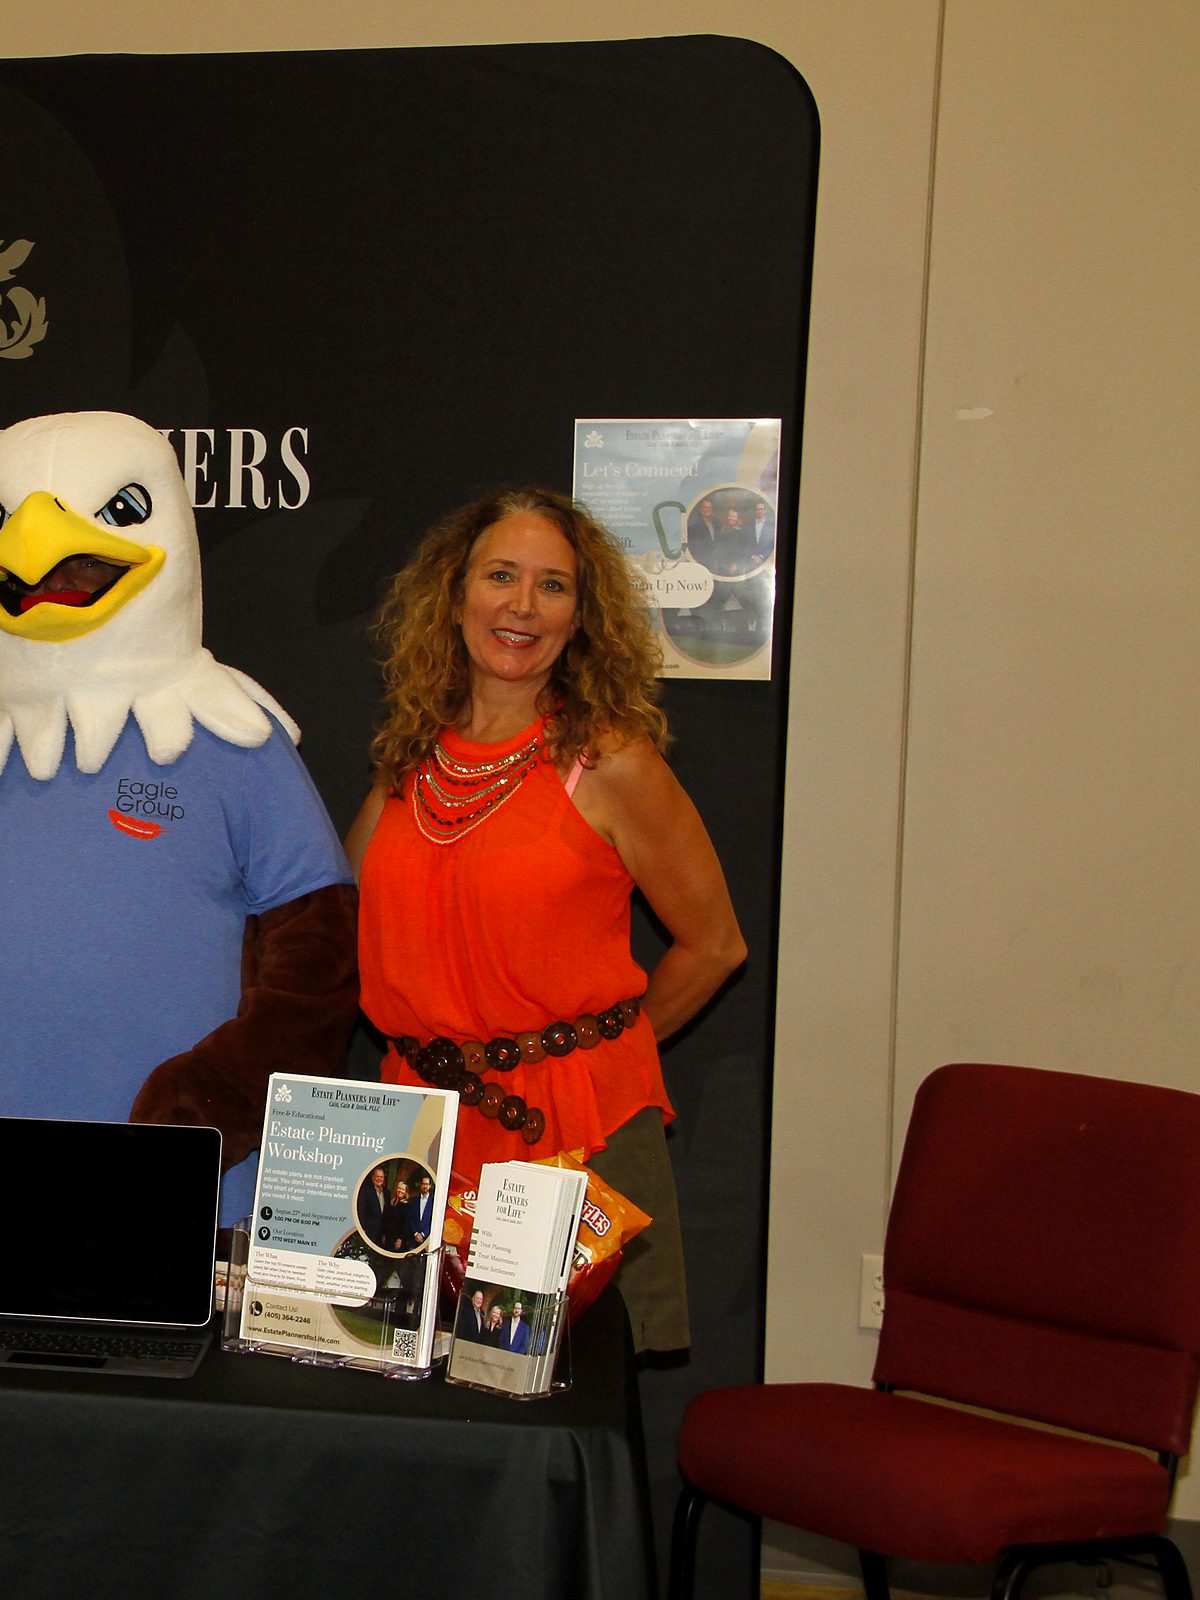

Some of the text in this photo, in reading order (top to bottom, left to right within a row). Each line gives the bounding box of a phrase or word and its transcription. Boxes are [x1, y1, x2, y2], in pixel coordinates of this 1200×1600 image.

[656, 579, 674, 594] Up
[677, 579, 708, 591] Now!
[117, 778, 178, 800] Eagle
[116, 794, 185, 821] Group
[311, 1087, 334, 1100] ESTATE
[335, 1089, 367, 1103] PLANNERS
[272, 1108, 285, 1116] Free
[291, 1111, 326, 1121] Educational
[270, 1121, 386, 1152] Estate Planning
[267, 1142, 343, 1169] Workshop
[503, 1179, 526, 1194] ESTATE
[496, 1190, 528, 1207] PLANNERS
[496, 1205, 507, 1215] FOR
[265, 1302, 288, 1311] Contact
[264, 1311, 311, 1324] (405) 364-2246
